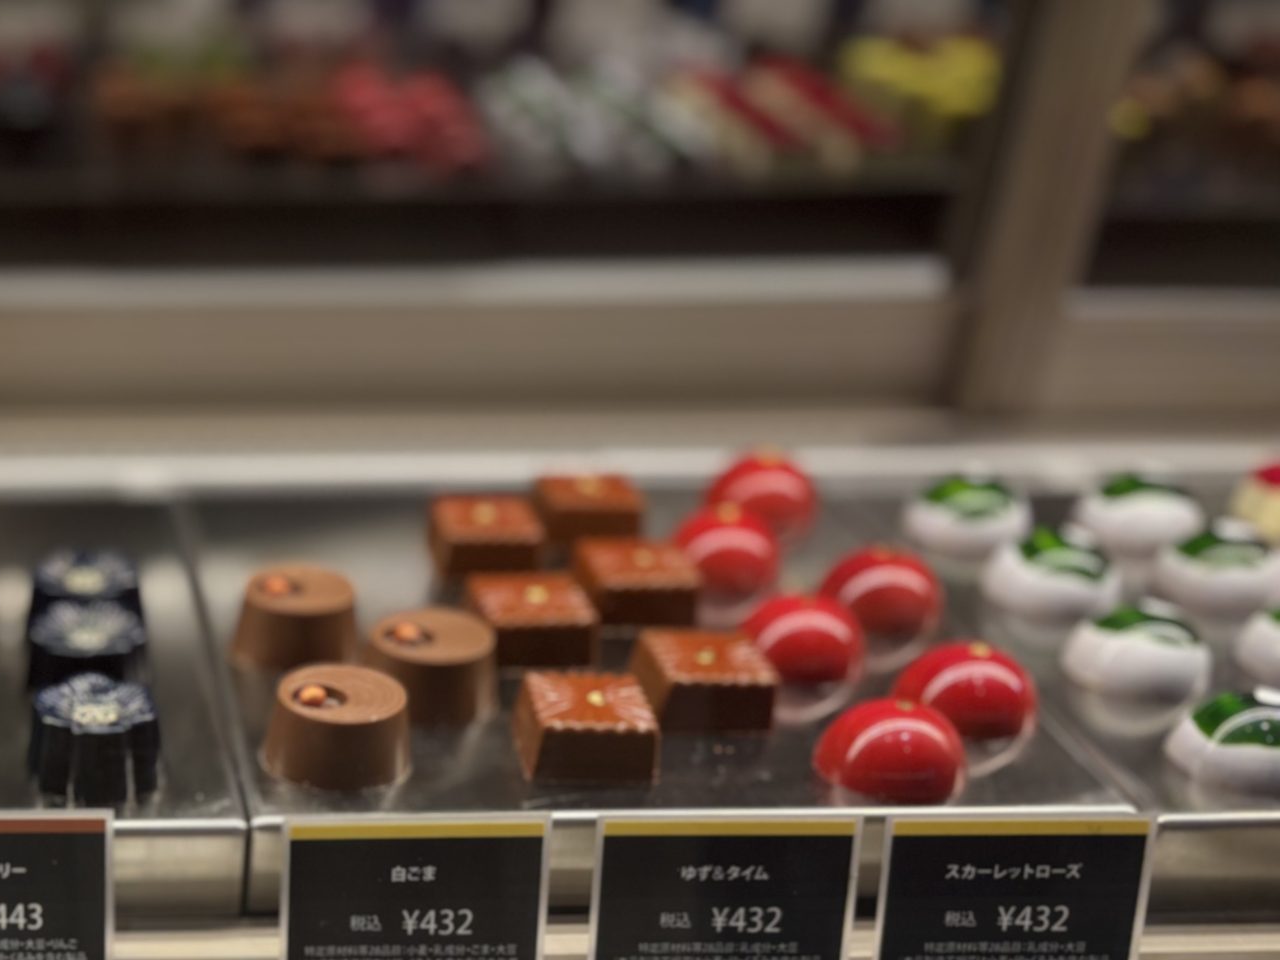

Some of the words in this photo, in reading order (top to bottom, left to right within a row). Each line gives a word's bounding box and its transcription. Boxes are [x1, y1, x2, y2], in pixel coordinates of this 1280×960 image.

[391, 865, 436, 882] 白ごま
[680, 865, 769, 881] ゆず&タイム
[945, 863, 1081, 880] スカーレットローズ
[350, 915, 381, 931] 税込
[402, 909, 473, 935] ¥432
[660, 912, 691, 928] 税込
[712, 907, 782, 933] ¥432
[944, 911, 976, 927] 税込
[996, 905, 1069, 932] ¥432
